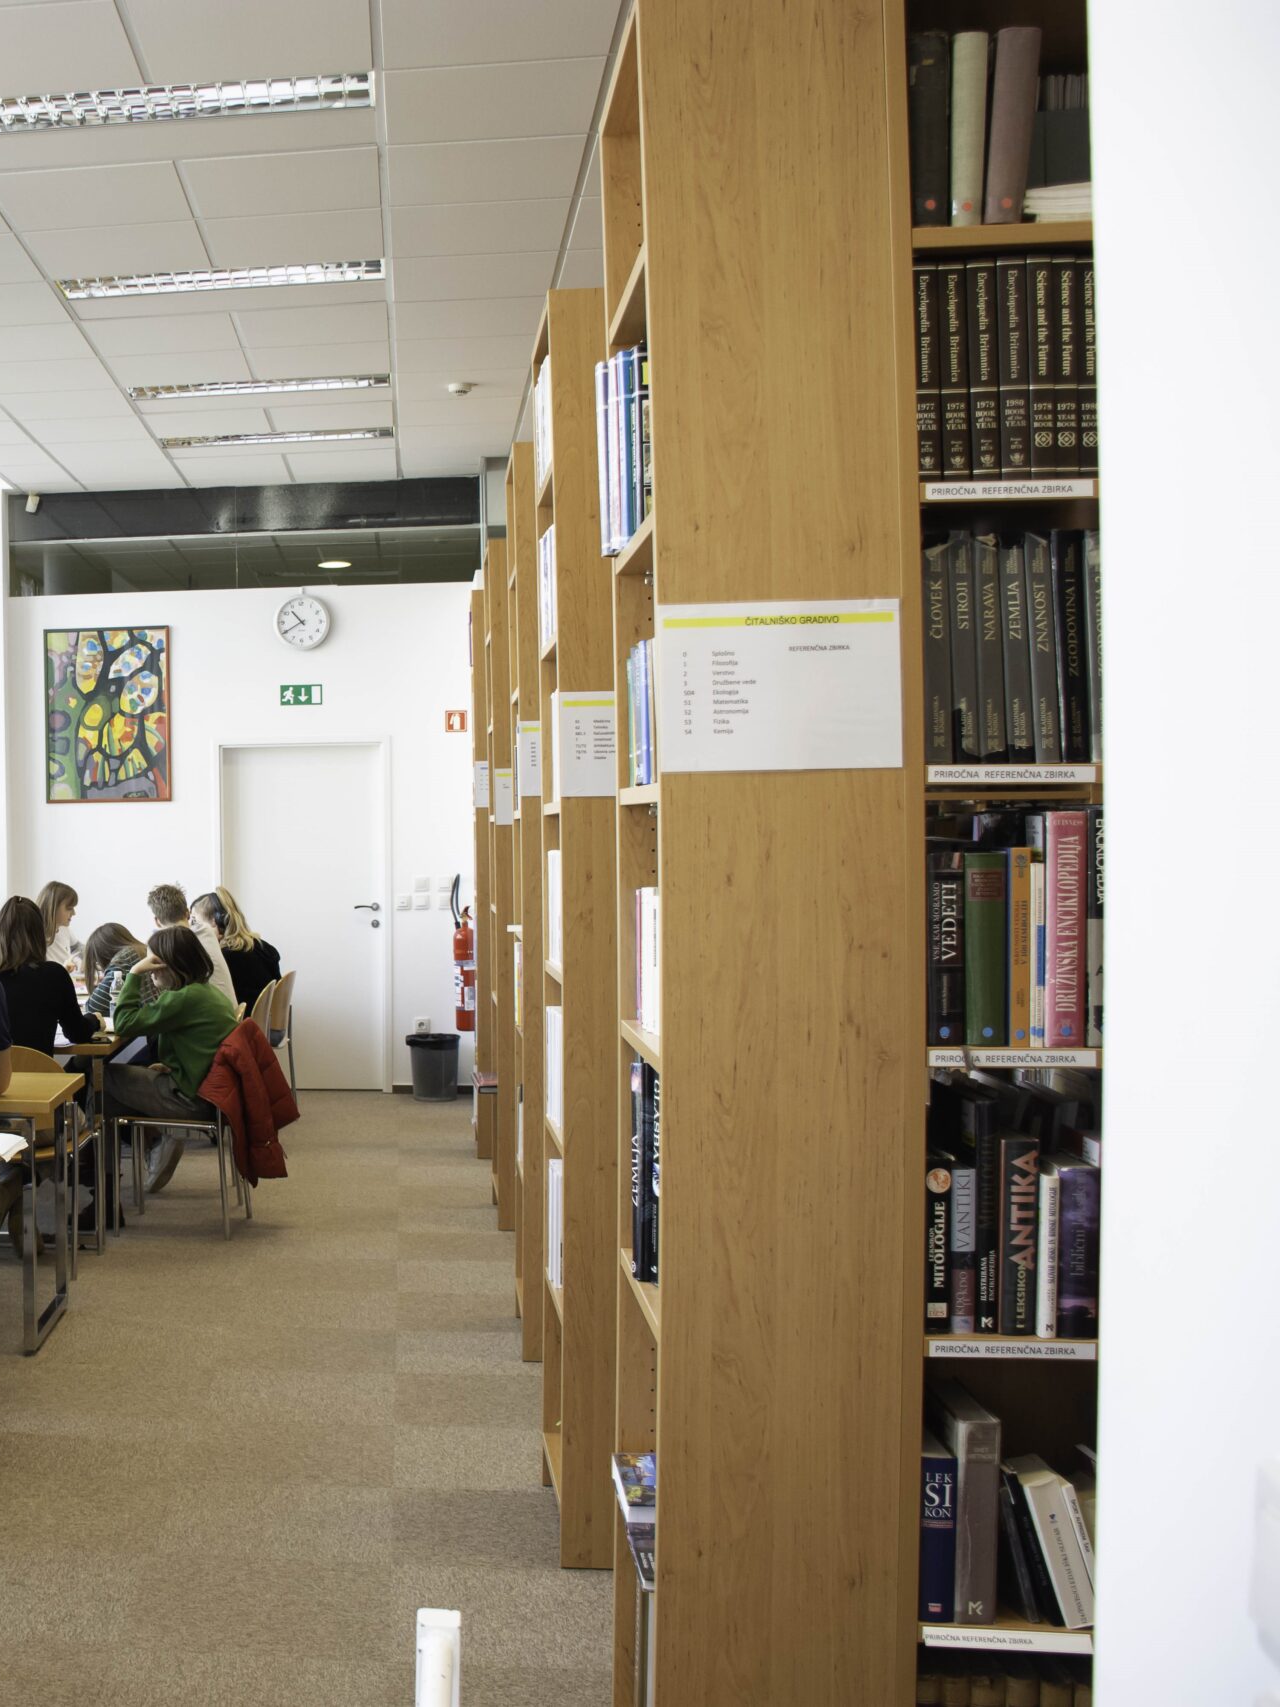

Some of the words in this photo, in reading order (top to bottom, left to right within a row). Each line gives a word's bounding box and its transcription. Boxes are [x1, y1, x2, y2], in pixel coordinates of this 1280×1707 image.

[1037, 271, 1047, 306] Science
[1062, 271, 1071, 306] Science
[1037, 309, 1048, 325] and
[1062, 309, 1072, 325] and
[1038, 328, 1048, 342] the
[1063, 328, 1072, 342] the
[920, 337, 931, 382] Britannica
[950, 336, 960, 382] Britannica
[980, 335, 990, 380] Britannica
[1010, 332, 1020, 378] Britannica
[1038, 345, 1048, 376] Future
[1063, 345, 1073, 376] Future
[932, 486, 976, 496] PRIROČNA
[982, 484, 1039, 494] REFERENČNA
[1042, 485, 1073, 493] ZBIRKA
[745, 616, 797, 626] ČITALNIŠKO
[799, 615, 839, 624] GRADIVO
[929, 578, 943, 639] ČLOVEK
[956, 582, 969, 630] STROJI
[984, 582, 996, 640] NARAVA
[1007, 581, 1022, 640] ZEMLJA
[1034, 582, 1049, 652] ZNANOST
[1066, 587, 1079, 677] ZGODOVINA
[934, 769, 979, 778] PRIROČNA
[985, 769, 1042, 778] REFERENČNA
[1057, 836, 1081, 936] ENCIKLOPEDIJA
[942, 883, 956, 960] VEDETI
[1049, 941, 1077, 1012] DRUŽINSKA
[986, 1054, 1042, 1063] REFERENČNA
[632, 1134, 640, 1207] ZEMLJA
[1008, 1149, 1039, 1271] ANTIKA
[934, 1202, 945, 1288] MITOLOGIJE
[959, 1271, 968, 1294] KDO
[1016, 1261, 1026, 1319] LEKSIKON
[935, 1345, 979, 1354] PRIROČNA
[985, 1345, 1042, 1354] REFERENČNA
[1044, 1347, 1076, 1355] ZBIRKA
[924, 1483, 952, 1507] SI
[926, 1472, 952, 1483] LEK
[925, 1507, 952, 1518] KON
[925, 1633, 960, 1641] PRIROČNA
